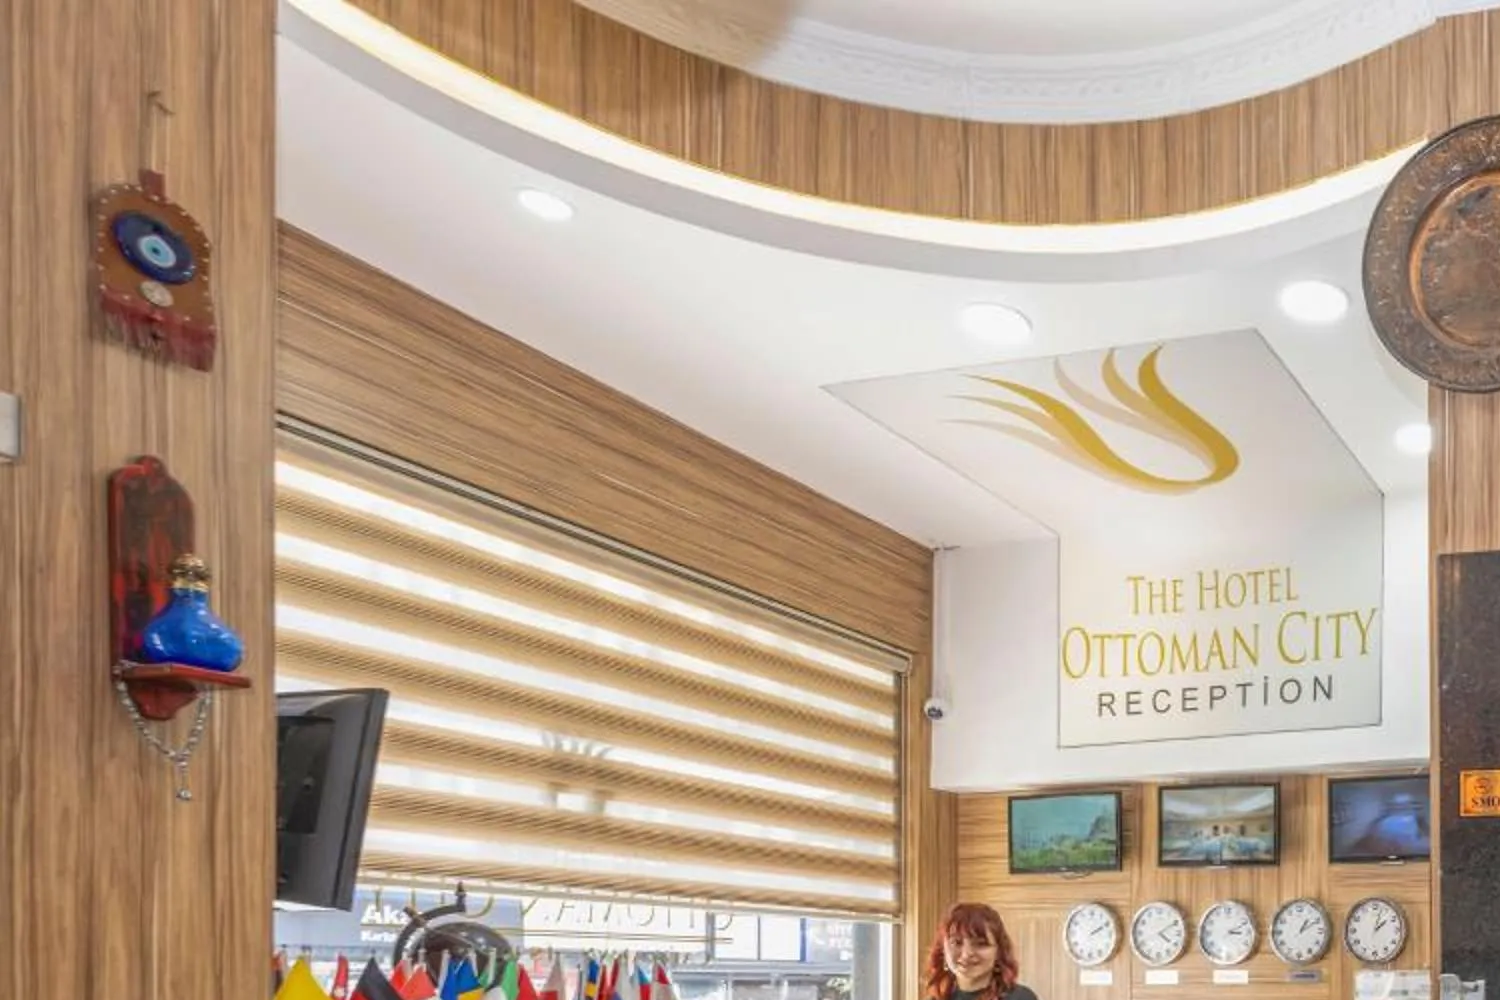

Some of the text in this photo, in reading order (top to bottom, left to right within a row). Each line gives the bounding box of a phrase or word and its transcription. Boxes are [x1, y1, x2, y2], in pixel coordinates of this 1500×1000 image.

[1126, 567, 1299, 615] THE HOTEL
[1062, 608, 1378, 680] OTTOMAN CITY
